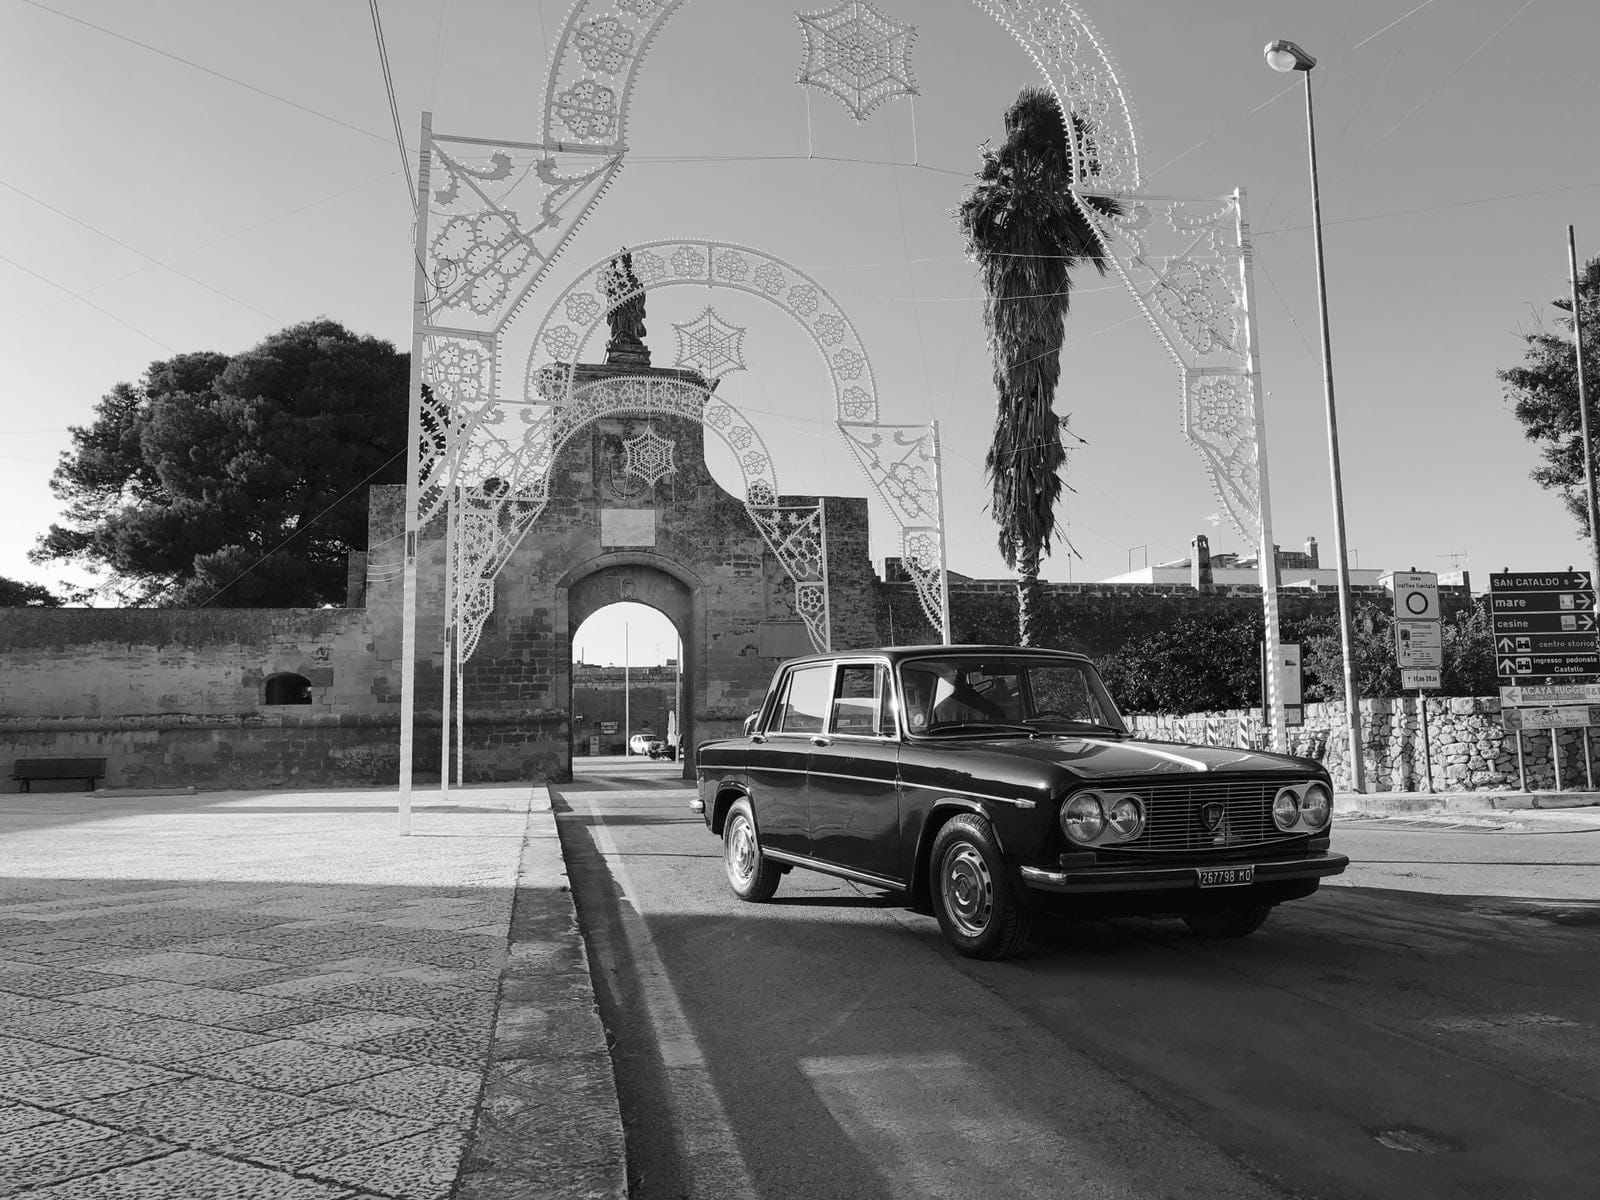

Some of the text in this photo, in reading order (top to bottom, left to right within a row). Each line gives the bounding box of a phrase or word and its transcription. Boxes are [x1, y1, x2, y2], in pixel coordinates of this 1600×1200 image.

[1493, 579, 1513, 587] SAN
[1515, 578, 1560, 586] CATALDO
[1495, 599, 1526, 607] mare
[1497, 619, 1529, 628] cesine
[1539, 639, 1595, 648] centro storico
[1522, 687, 1553, 695] ACAYA
[1202, 869, 1251, 884] 267798 MO
